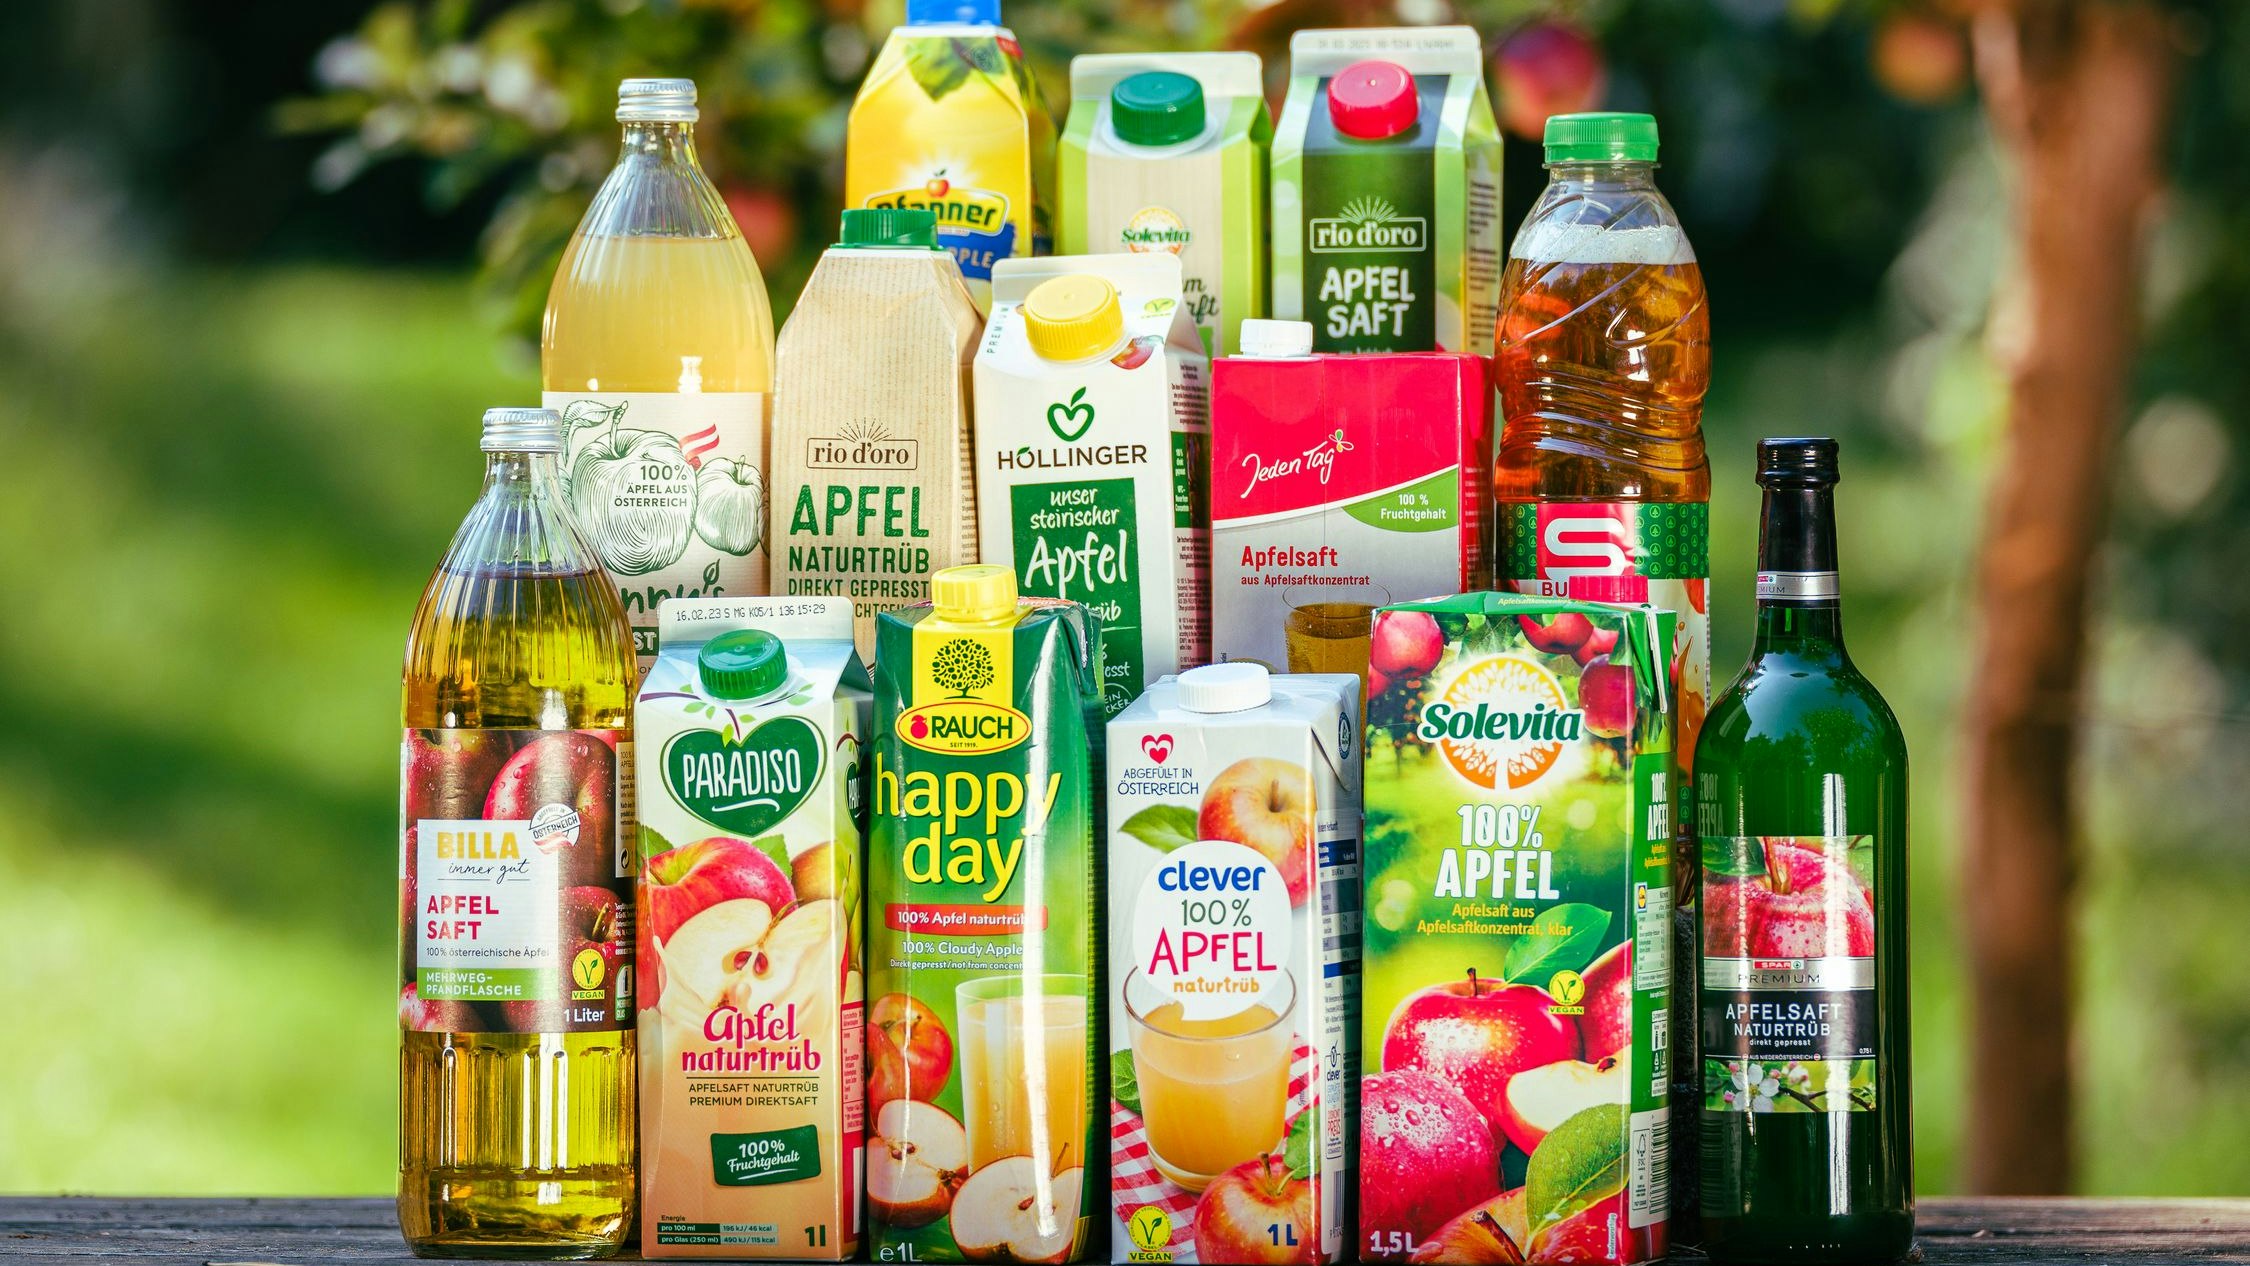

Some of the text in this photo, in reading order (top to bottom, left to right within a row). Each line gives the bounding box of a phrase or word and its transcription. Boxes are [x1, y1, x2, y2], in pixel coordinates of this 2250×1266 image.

[1317, 223, 1352, 246] rio
[1319, 266, 1416, 302] APFEL
[1327, 303, 1409, 338] SAFT
[813, 443, 847, 463] rio
[640, 465, 687, 481] 100%
[1240, 453, 1301, 499] Jeden
[1303, 440, 1336, 484] Tag
[626, 482, 687, 494] ÄPFEL AUS
[1050, 487, 1099, 507] unser
[614, 495, 687, 508] ÖSTERREICH
[1398, 494, 1429, 506] 100 %
[789, 483, 930, 538] APFEL
[1029, 505, 1121, 530] steirischer
[1380, 508, 1447, 523] Fruchtgehalt
[788, 542, 930, 574] NATURTRÜB
[1024, 529, 1128, 600] Apfel
[1241, 546, 1338, 571] Apfelsaft
[788, 578, 930, 598] DIREKT GEPRESST
[1241, 573, 1370, 587] aus Apfelsaftkonzentrat
[676, 609, 722, 621] 16.02.23
[724, 609, 730, 618] S
[733, 608, 746, 618] MG
[779, 605, 795, 616] 136
[798, 604, 826, 616] 15:29
[931, 716, 1014, 740] RAUCH
[1422, 703, 1581, 741] Solevita
[682, 748, 801, 799] PARADISO
[1123, 765, 1193, 779] ABGEFÜLLT IN
[876, 752, 1062, 837] happy
[1117, 780, 1200, 796] ÖSTERREICH
[1457, 803, 1544, 849] 100%
[1647, 803, 1670, 841] APFEL
[437, 831, 520, 860] BILLA
[449, 859, 531, 884] immer gut
[902, 821, 1024, 904] day
[1158, 861, 1266, 892] clever
[1433, 848, 1561, 900] APFEL
[427, 895, 499, 915] APFEL
[1452, 903, 1535, 919] Apfelsaft aus
[897, 911, 929, 924] 100%
[932, 911, 966, 926] Apfel
[1417, 919, 1574, 937] Apfelsaftkonzentrat, klar
[427, 921, 482, 940] SAFT
[449, 946, 521, 957] österreichische
[902, 941, 1024, 958] 100% Cloudy Apple
[1148, 927, 1278, 976] APFEL
[890, 959, 911, 968] Direkt
[967, 961, 988, 969] from
[426, 972, 493, 984] MEHRWEG-
[1173, 976, 1260, 993] naturtrüb
[1737, 974, 1820, 984] PREMIUM
[426, 984, 522, 997] PFANDFLASCHE
[572, 991, 604, 999] VEGAN
[564, 1009, 570, 1022] 1
[574, 1008, 606, 1022] Liter
[1549, 1006, 1584, 1015] VEGAN
[1725, 1003, 1843, 1021] APFELSAFT
[703, 1003, 801, 1048] Apfel
[1734, 1021, 1831, 1037] NATURTRÜB
[1749, 1039, 1811, 1048] direkt gepresst
[681, 1039, 822, 1072] naturtrüb
[688, 1081, 819, 1093] APFELSAFT NATURTRÜB
[689, 1096, 817, 1106] PREMIUM DIREKTSAFT
[738, 1139, 786, 1158] 100%
[727, 1150, 801, 1173] Fruchtgehalt
[1129, 1252, 1172, 1261] VEGAN
